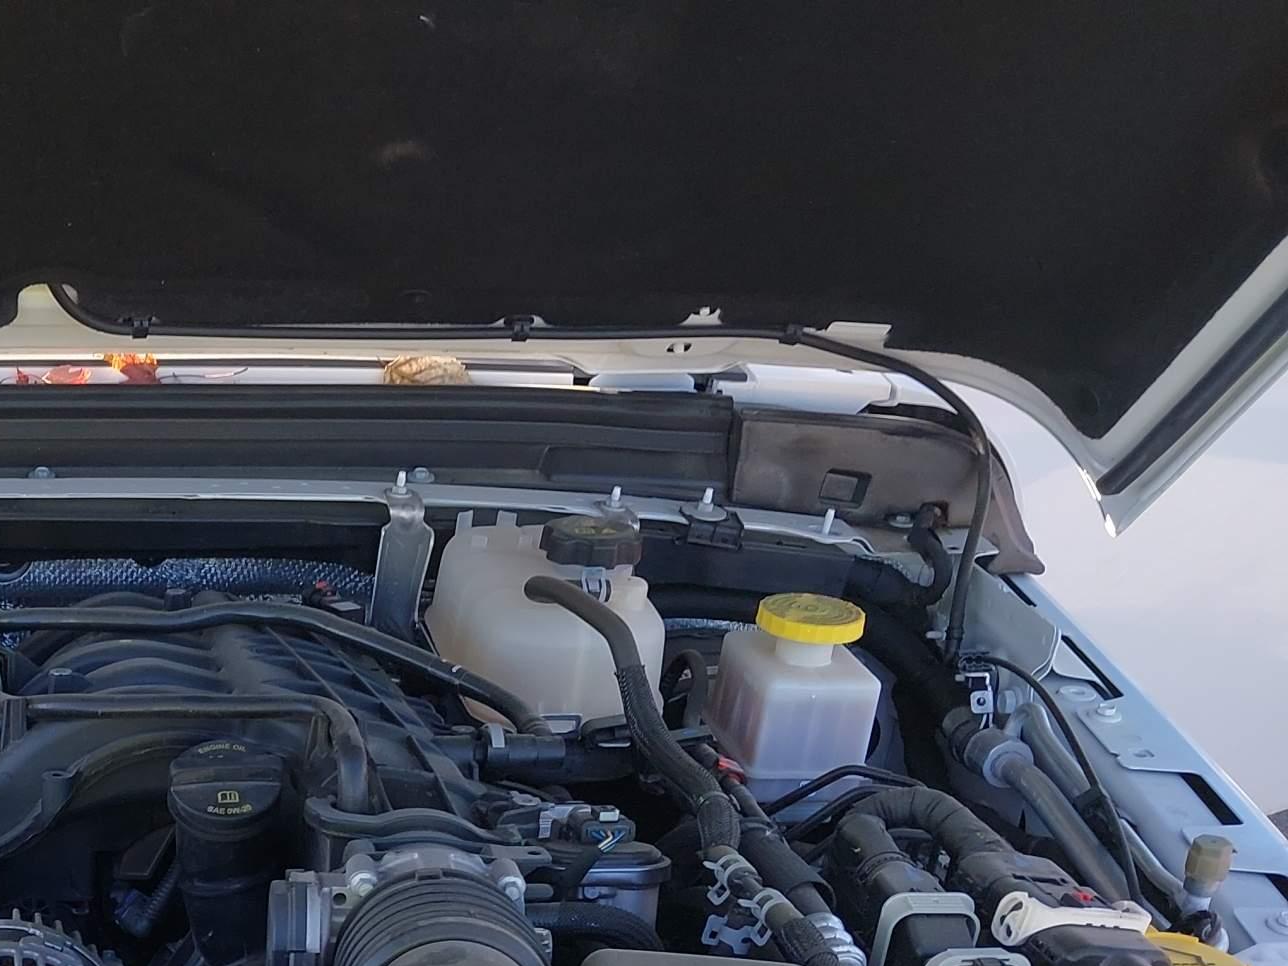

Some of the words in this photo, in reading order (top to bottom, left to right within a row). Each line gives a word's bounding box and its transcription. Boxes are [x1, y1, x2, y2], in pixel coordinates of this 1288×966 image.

[198, 743, 231, 754] ENGINE
[232, 743, 247, 753] OIL
[207, 805, 226, 815] SAE
